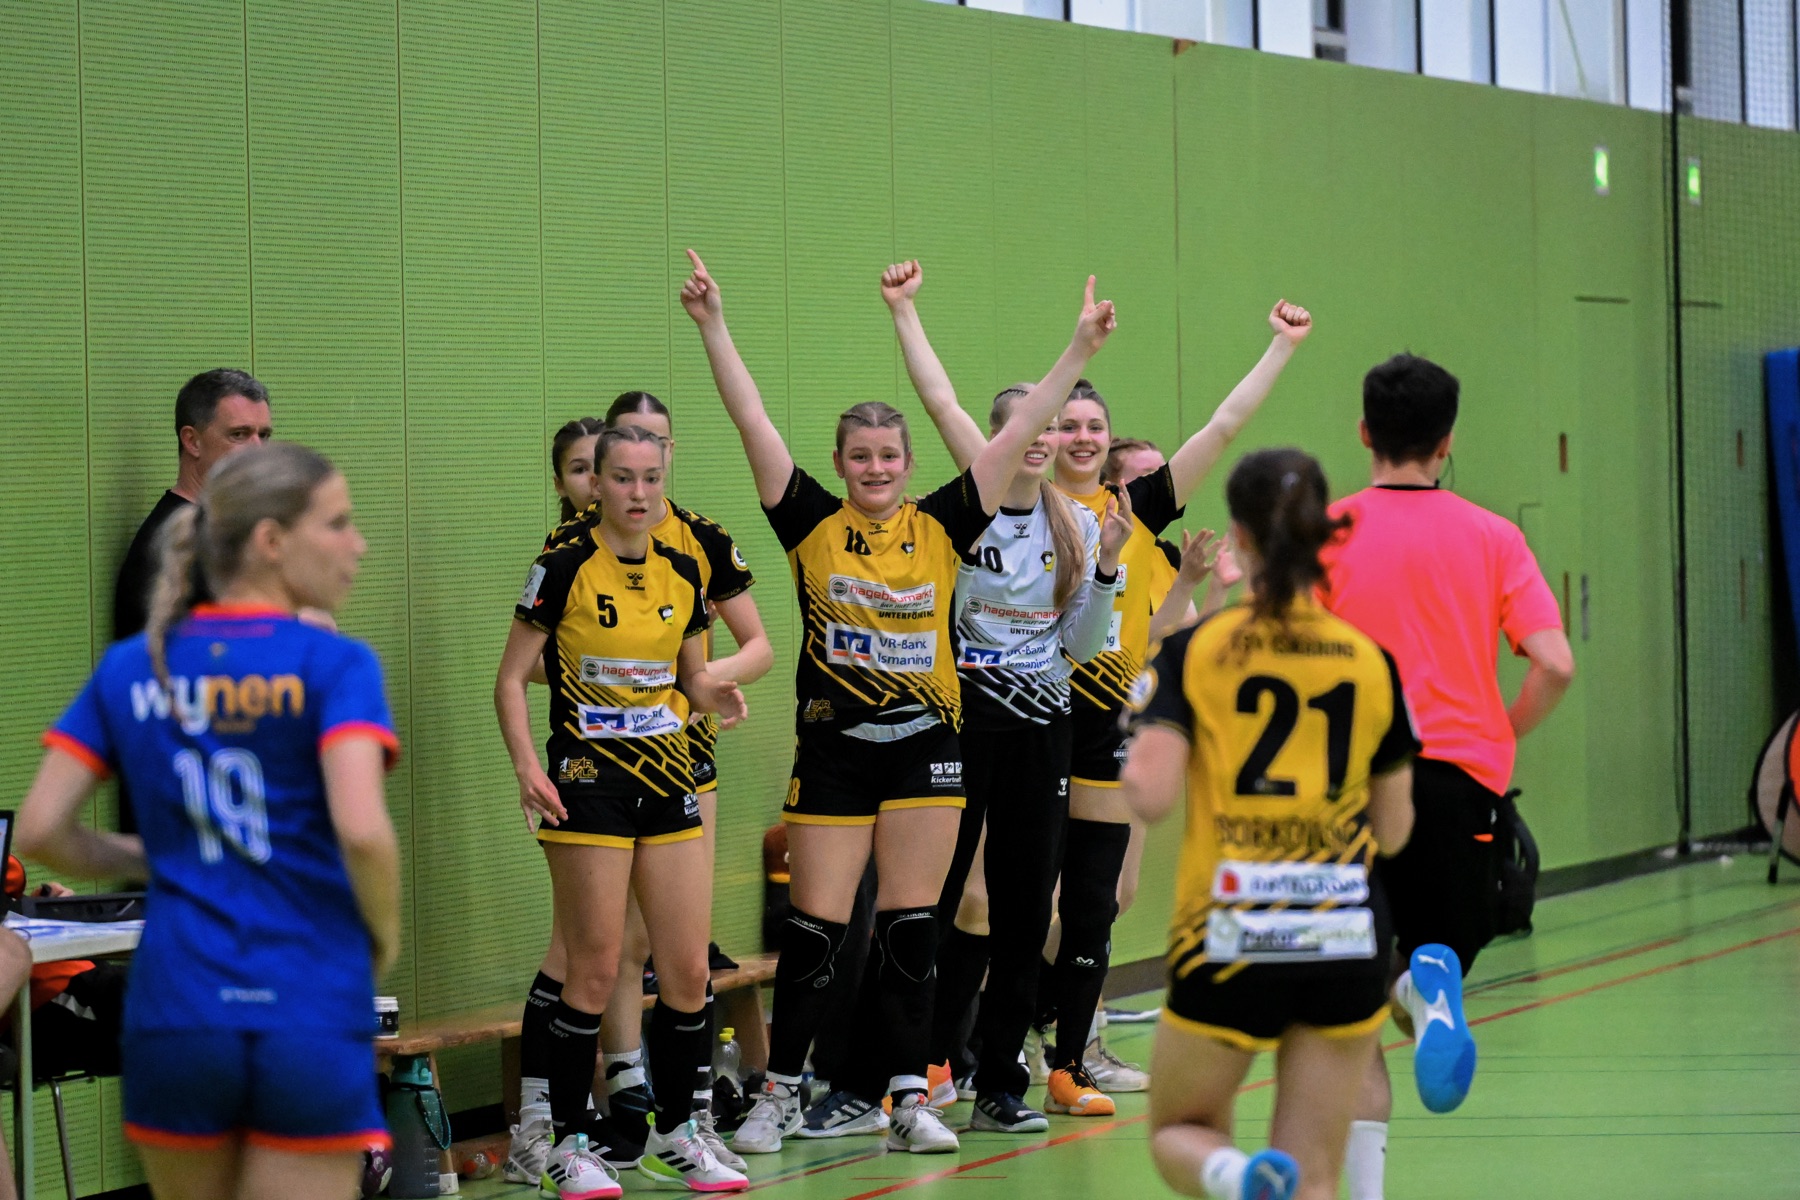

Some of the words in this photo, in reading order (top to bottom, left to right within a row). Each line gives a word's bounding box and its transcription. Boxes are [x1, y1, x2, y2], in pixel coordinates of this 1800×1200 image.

[844, 525, 872, 556] 18
[850, 583, 933, 603] hagebaumarkt
[596, 593, 618, 628] 5
[879, 636, 927, 650] VR-Bank
[878, 653, 933, 667] Ismaning
[130, 674, 305, 736] wynen
[1236, 675, 1356, 802] 21
[559, 768, 598, 780] DEVILS
[568, 757, 593, 768] ISAR
[173, 747, 272, 864] 19
